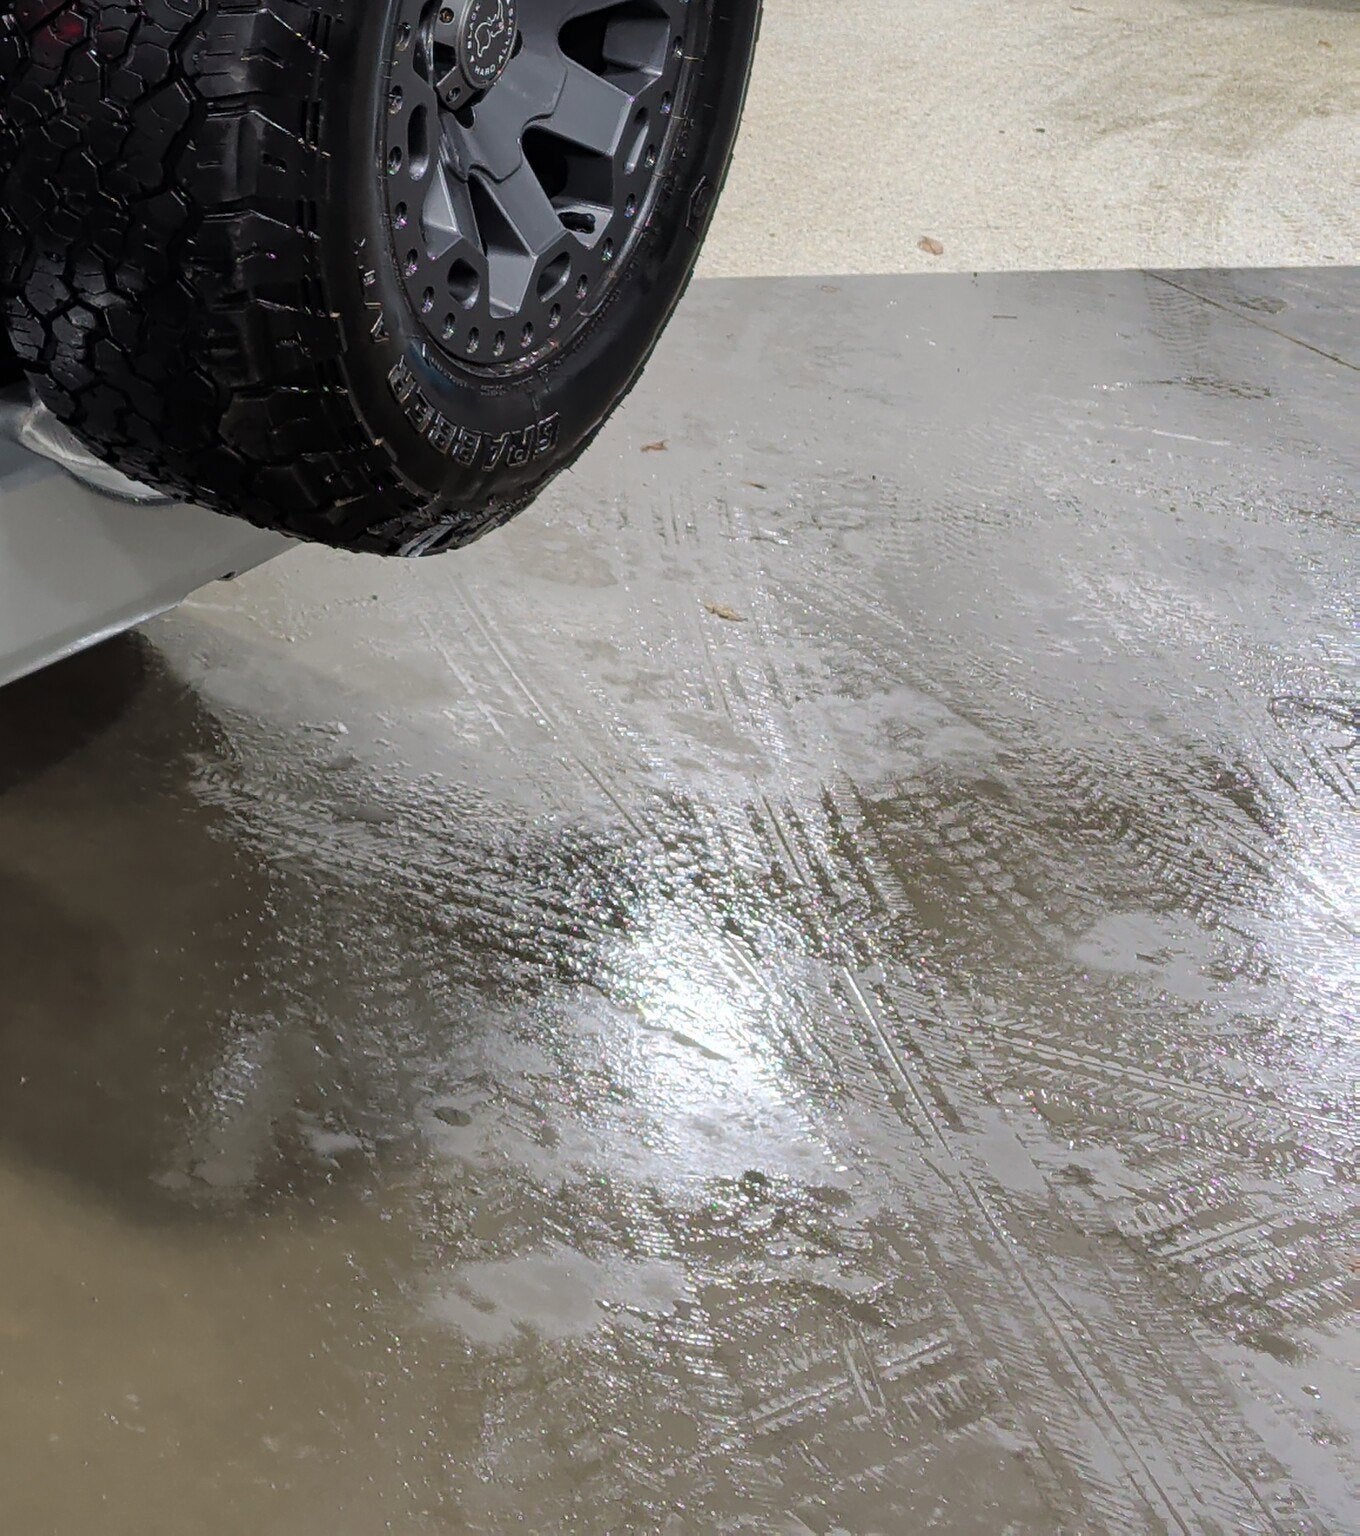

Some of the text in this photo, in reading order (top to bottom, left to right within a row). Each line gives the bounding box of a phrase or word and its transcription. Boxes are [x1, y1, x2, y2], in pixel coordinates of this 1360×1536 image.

[474, 8, 514, 76] HARD ALLOYS
[387, 355, 560, 472] GRABBER
